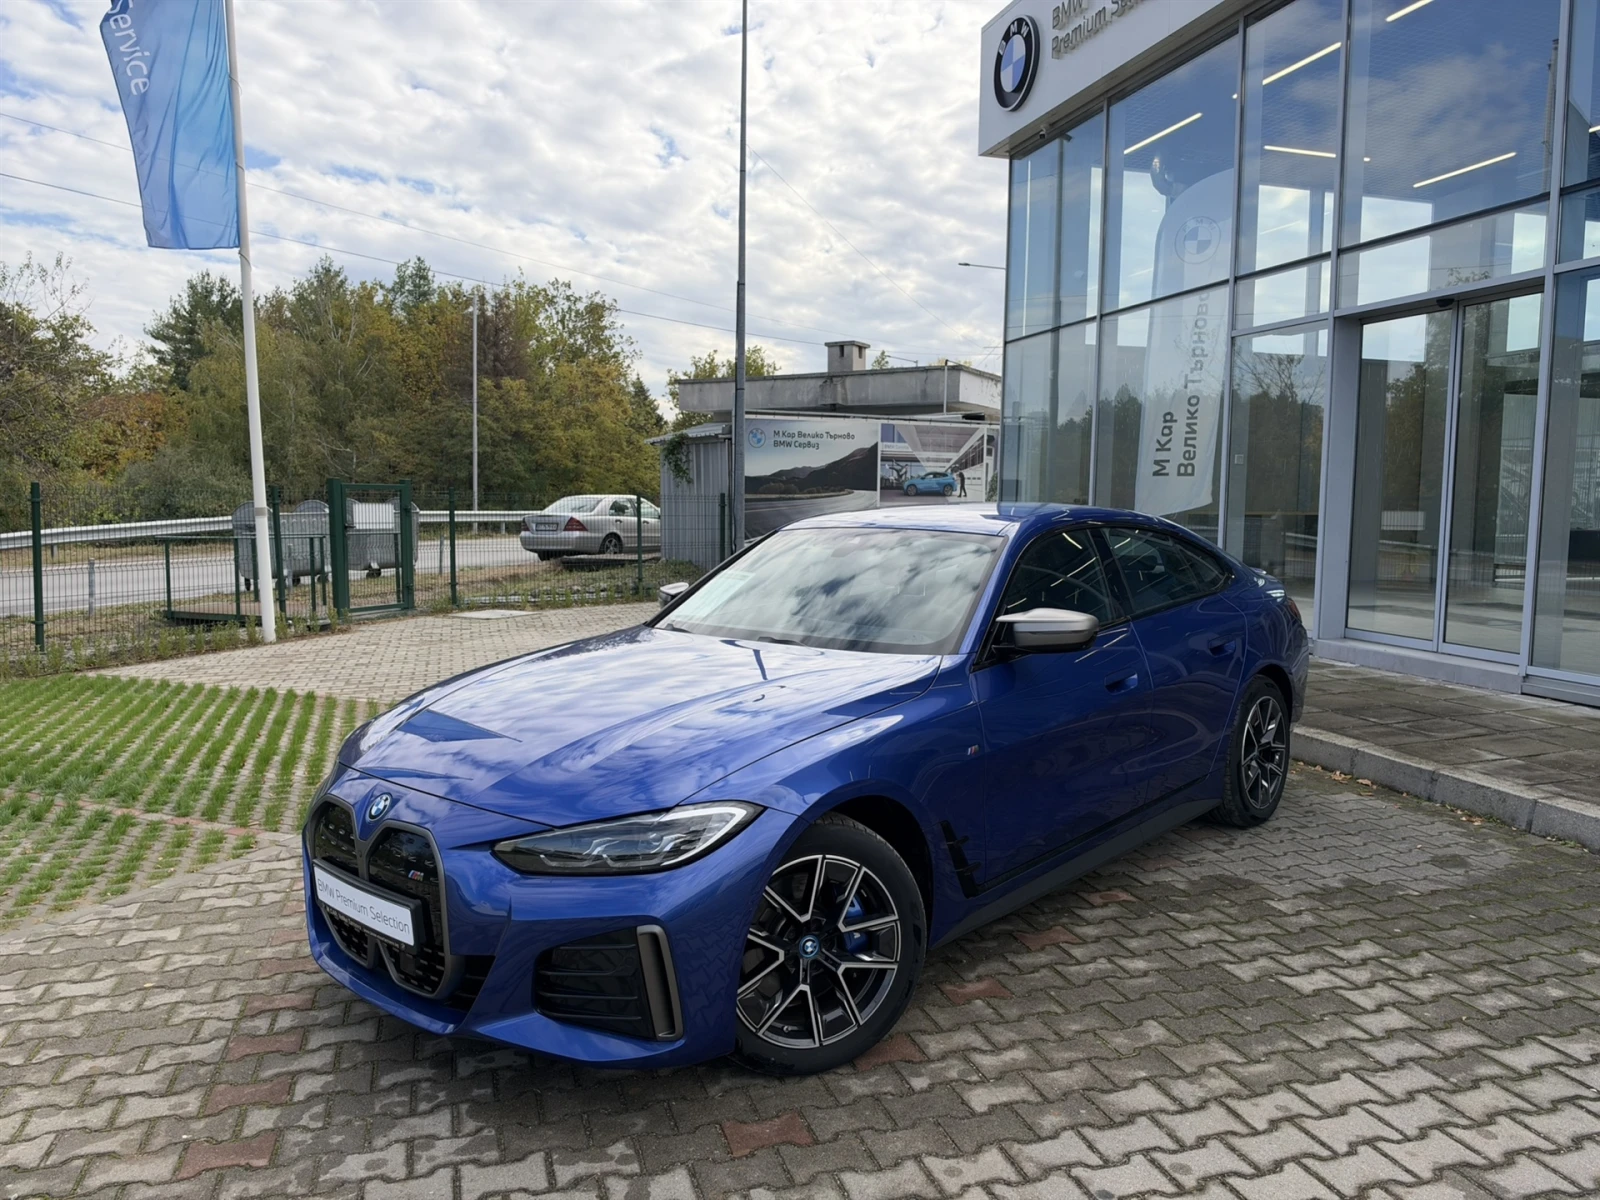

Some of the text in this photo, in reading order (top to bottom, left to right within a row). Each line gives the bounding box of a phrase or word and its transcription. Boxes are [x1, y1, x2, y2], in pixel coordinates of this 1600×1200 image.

[1052, 0, 1083, 30] BMW
[1052, 6, 1107, 58] Premium
[773, 440, 820, 450] BMW Сервиз
[797, 431, 824, 439] Велико
[825, 431, 856, 440] Търново
[1152, 411, 1178, 477] М Кар
[1177, 395, 1200, 477] Велико
[317, 879, 335, 898] BMW
[335, 889, 369, 917] Premium
[370, 906, 410, 934] Selection
